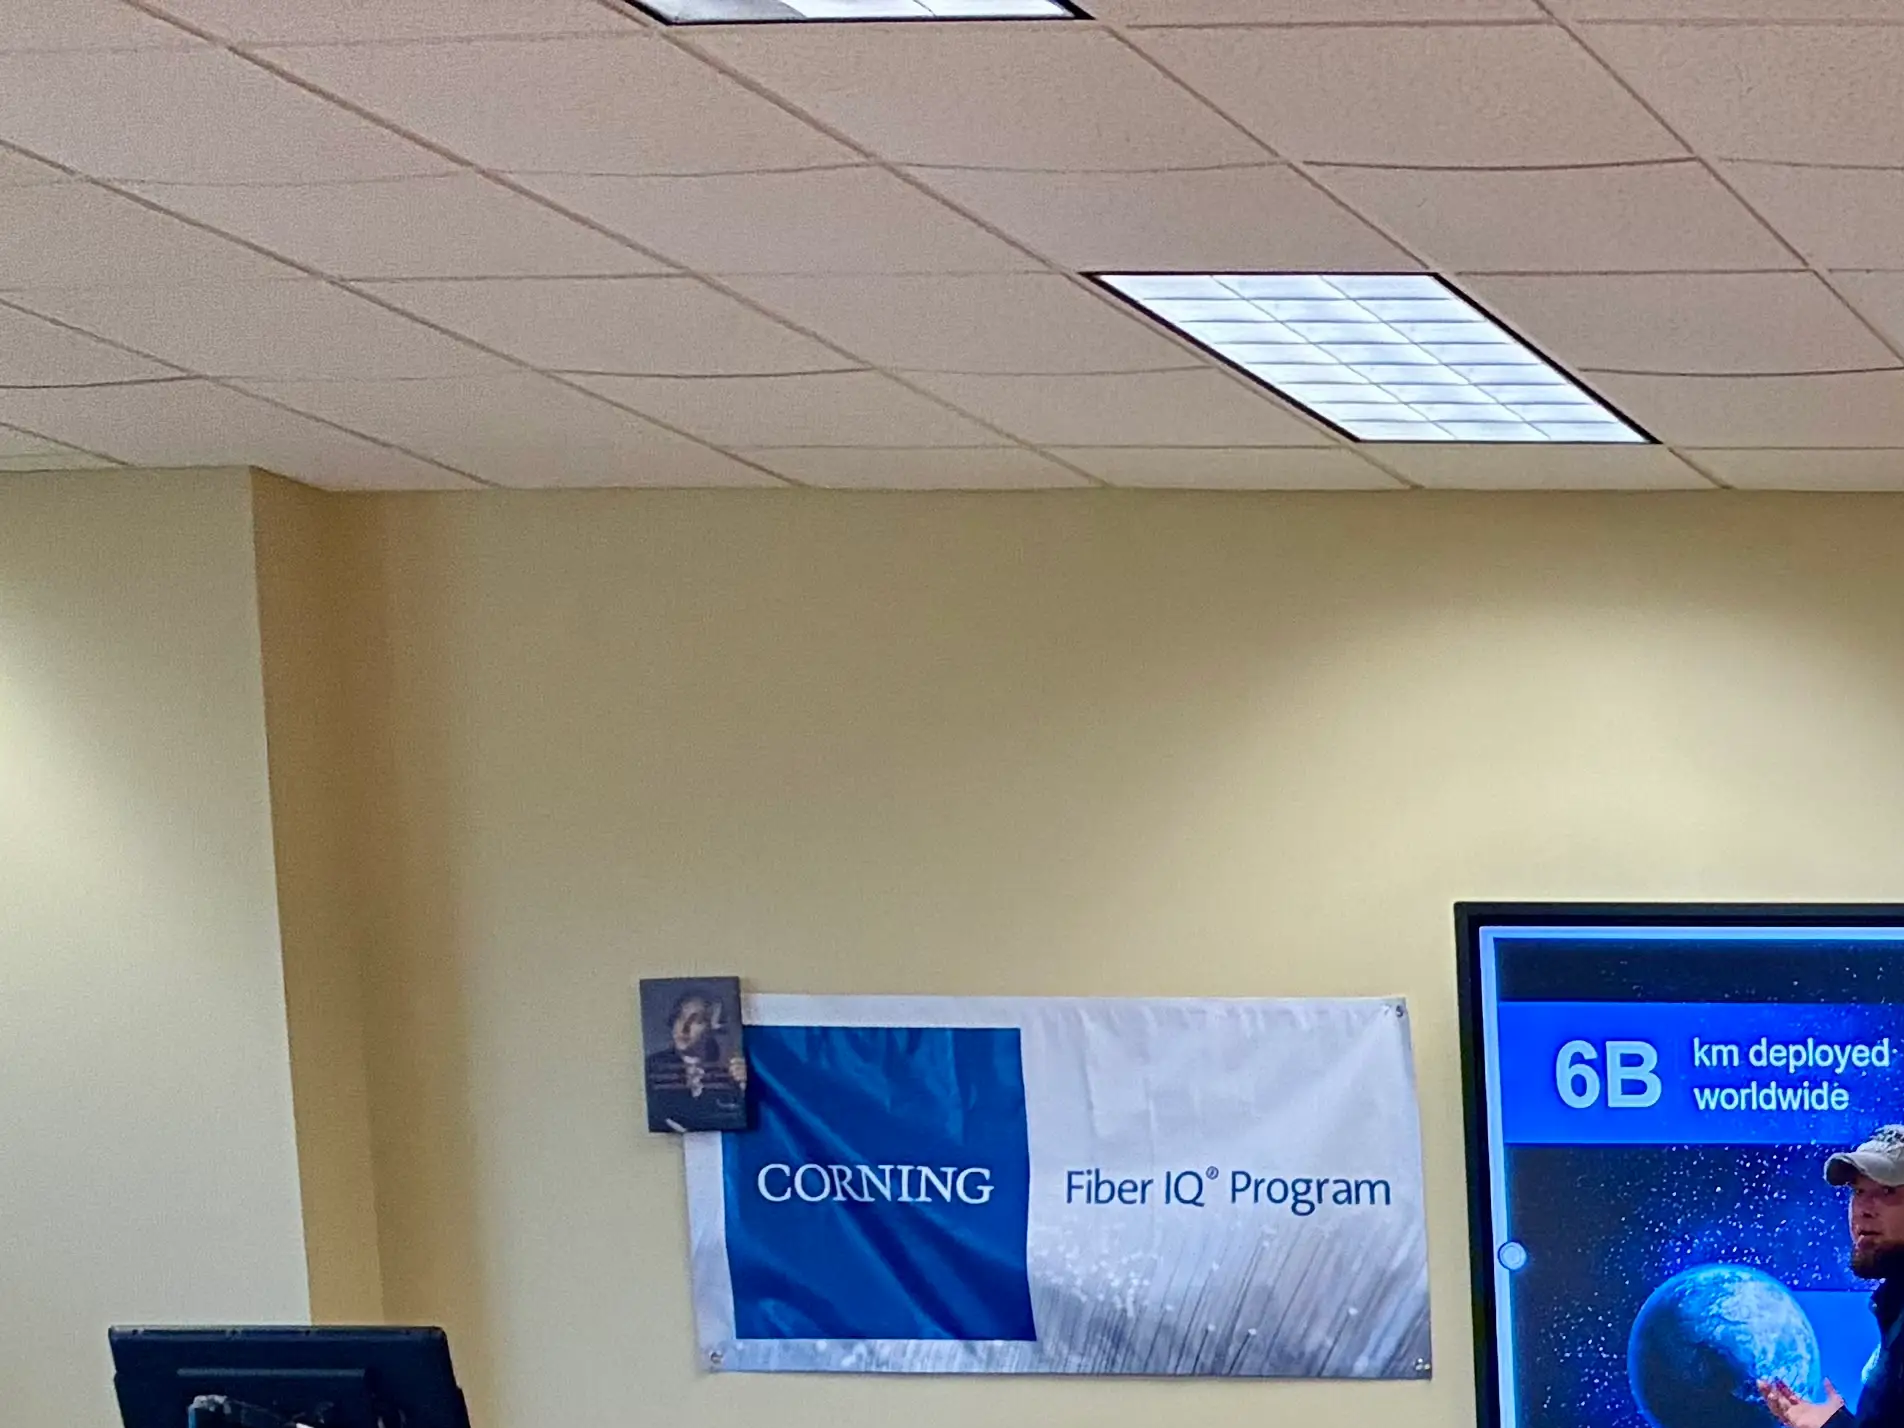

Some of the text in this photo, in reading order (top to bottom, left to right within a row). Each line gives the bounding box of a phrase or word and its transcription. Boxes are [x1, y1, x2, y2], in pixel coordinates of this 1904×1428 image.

[1555, 1039, 1663, 1109] 6B
[1693, 1037, 1891, 1075] km deployed
[1693, 1080, 1850, 1111] worldwide
[757, 1163, 995, 1205] CORNING
[1066, 1168, 1154, 1205] Fiber
[1231, 1170, 1391, 1217] Program
